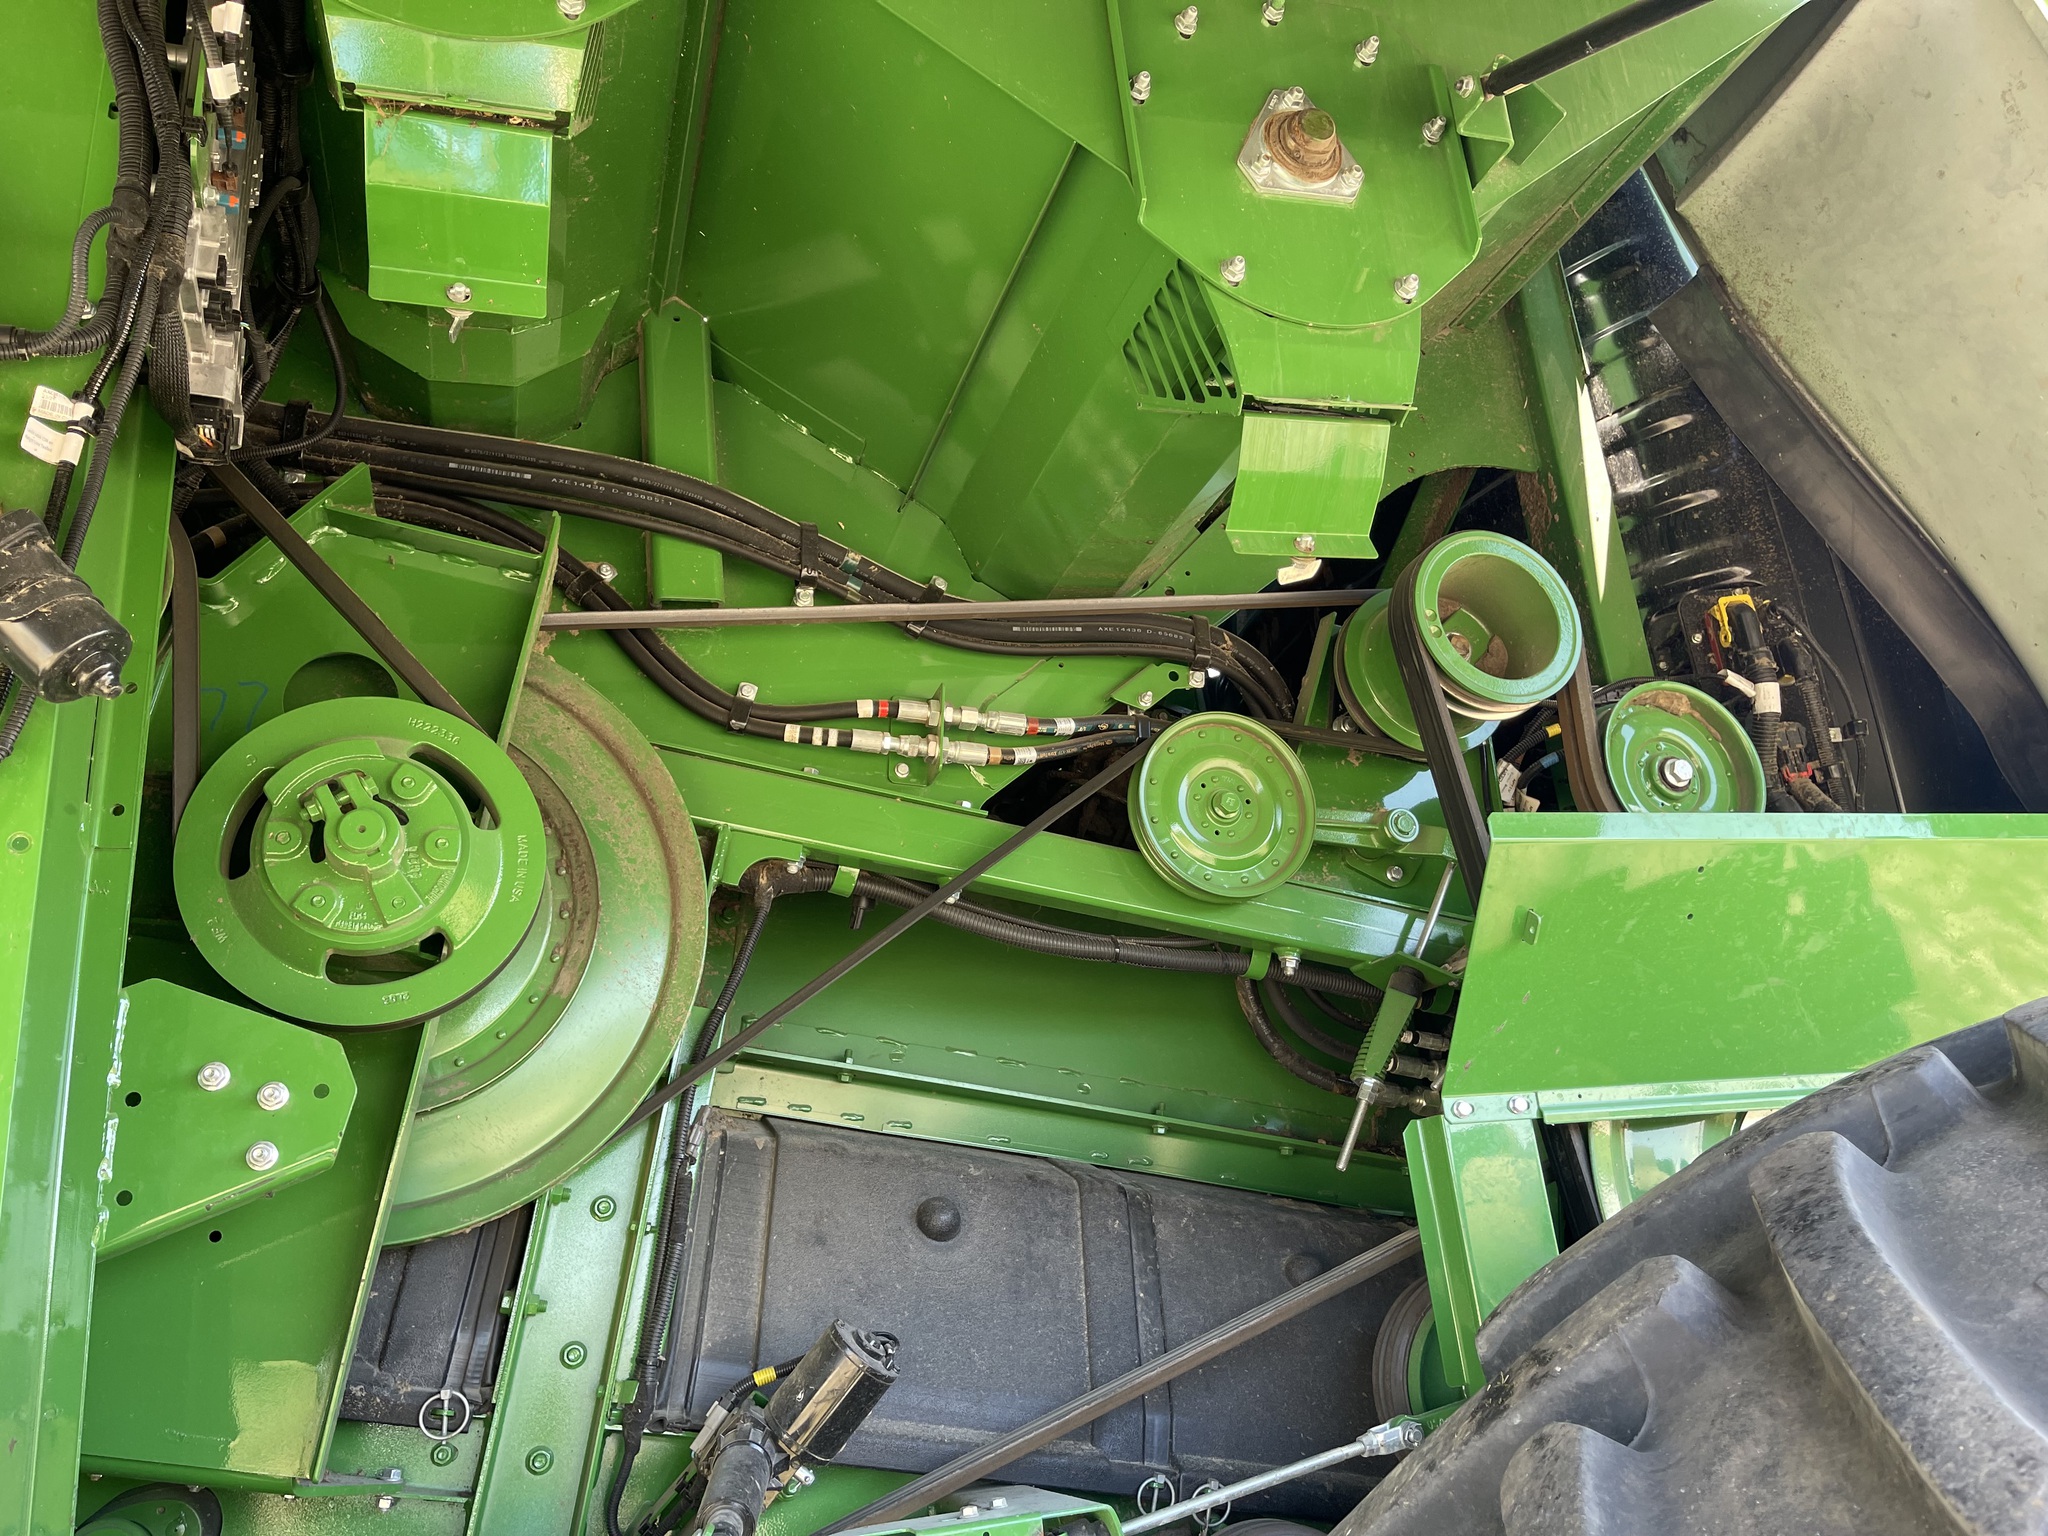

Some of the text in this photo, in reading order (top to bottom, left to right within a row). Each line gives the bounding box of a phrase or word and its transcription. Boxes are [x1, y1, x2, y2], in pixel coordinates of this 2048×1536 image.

[408, 717, 461, 745] H222336
[509, 834, 529, 903] MADE IN USA
